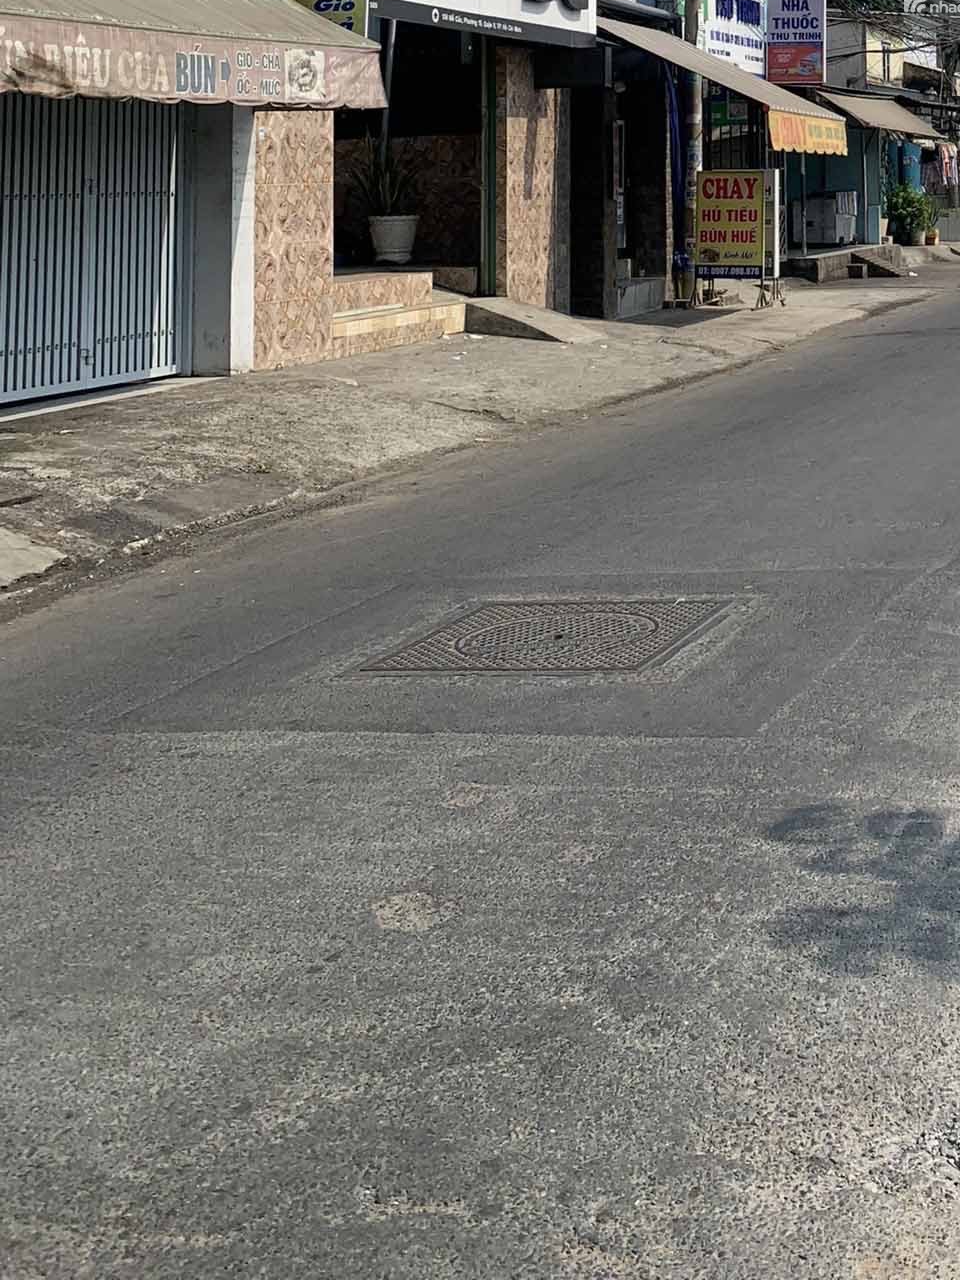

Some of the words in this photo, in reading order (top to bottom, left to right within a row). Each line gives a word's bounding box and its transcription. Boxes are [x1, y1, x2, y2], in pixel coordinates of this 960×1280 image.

[772, 12, 819, 29] THUỐC
[118, 49, 170, 92] CUA
[175, 43, 216, 94] BÚN
[702, 177, 759, 199] CHAY
[700, 227, 727, 243] BÚN
[731, 225, 758, 243] HUẾ
